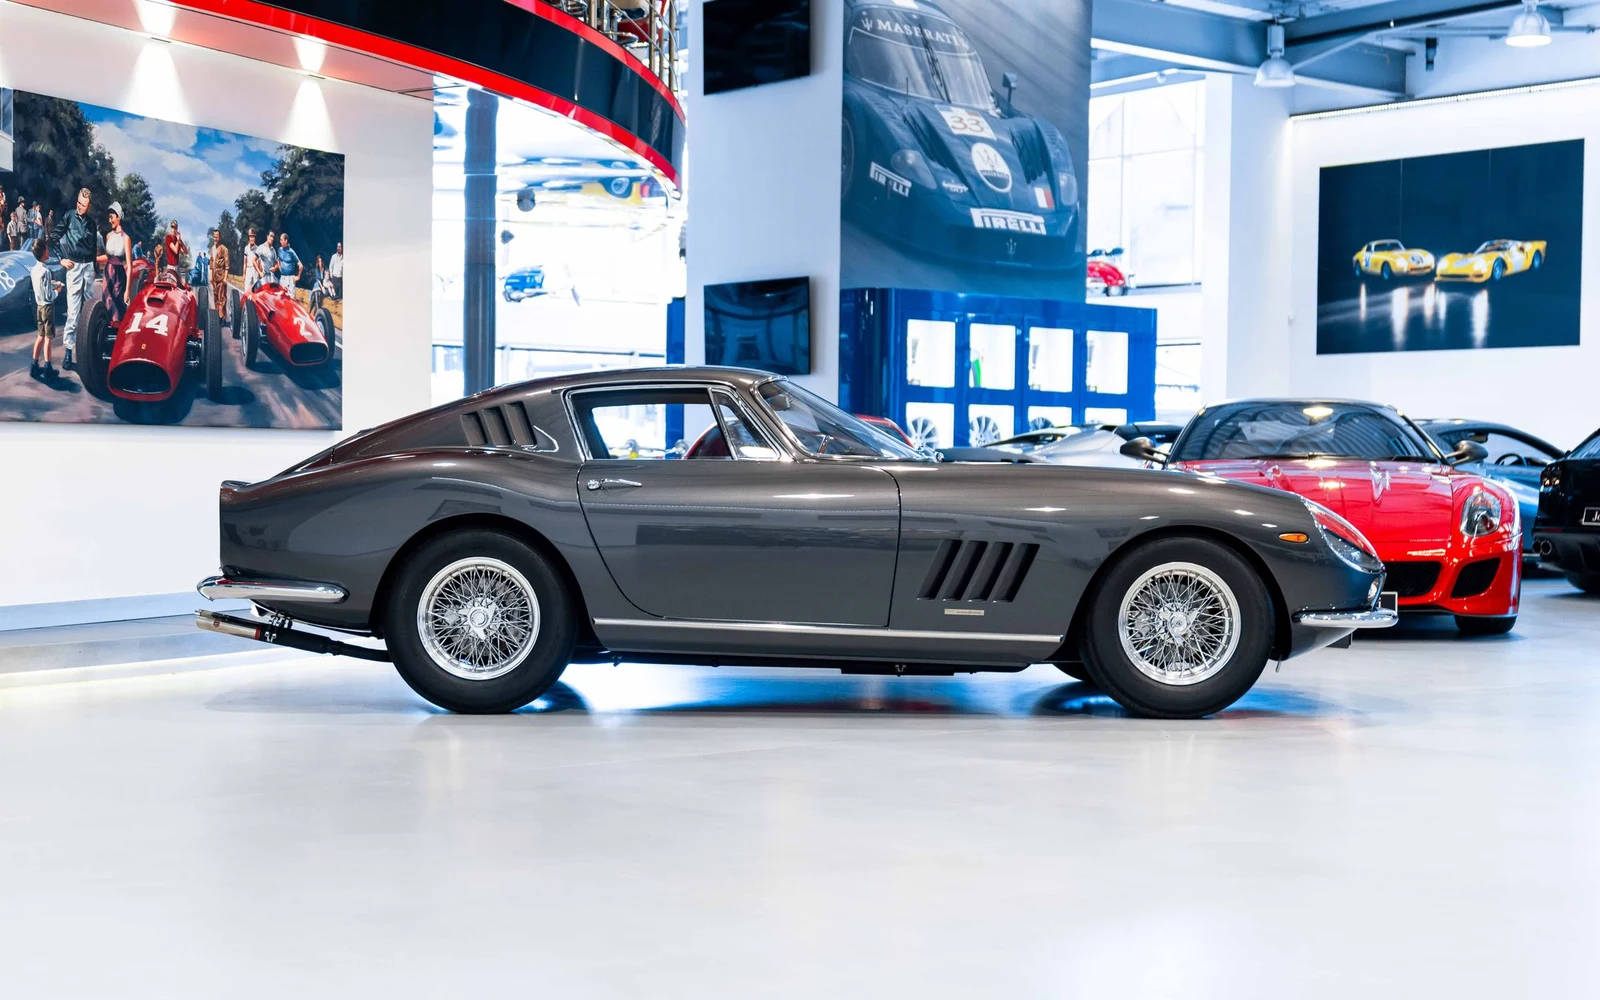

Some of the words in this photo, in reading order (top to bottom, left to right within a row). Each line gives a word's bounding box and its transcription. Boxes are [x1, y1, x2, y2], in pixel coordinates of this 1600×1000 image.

[877, 19, 960, 46] MASERATI
[950, 115, 985, 133] 33
[869, 161, 912, 197] PIRLLI
[970, 207, 1047, 236] PIRELLI
[125, 312, 169, 337] 14
